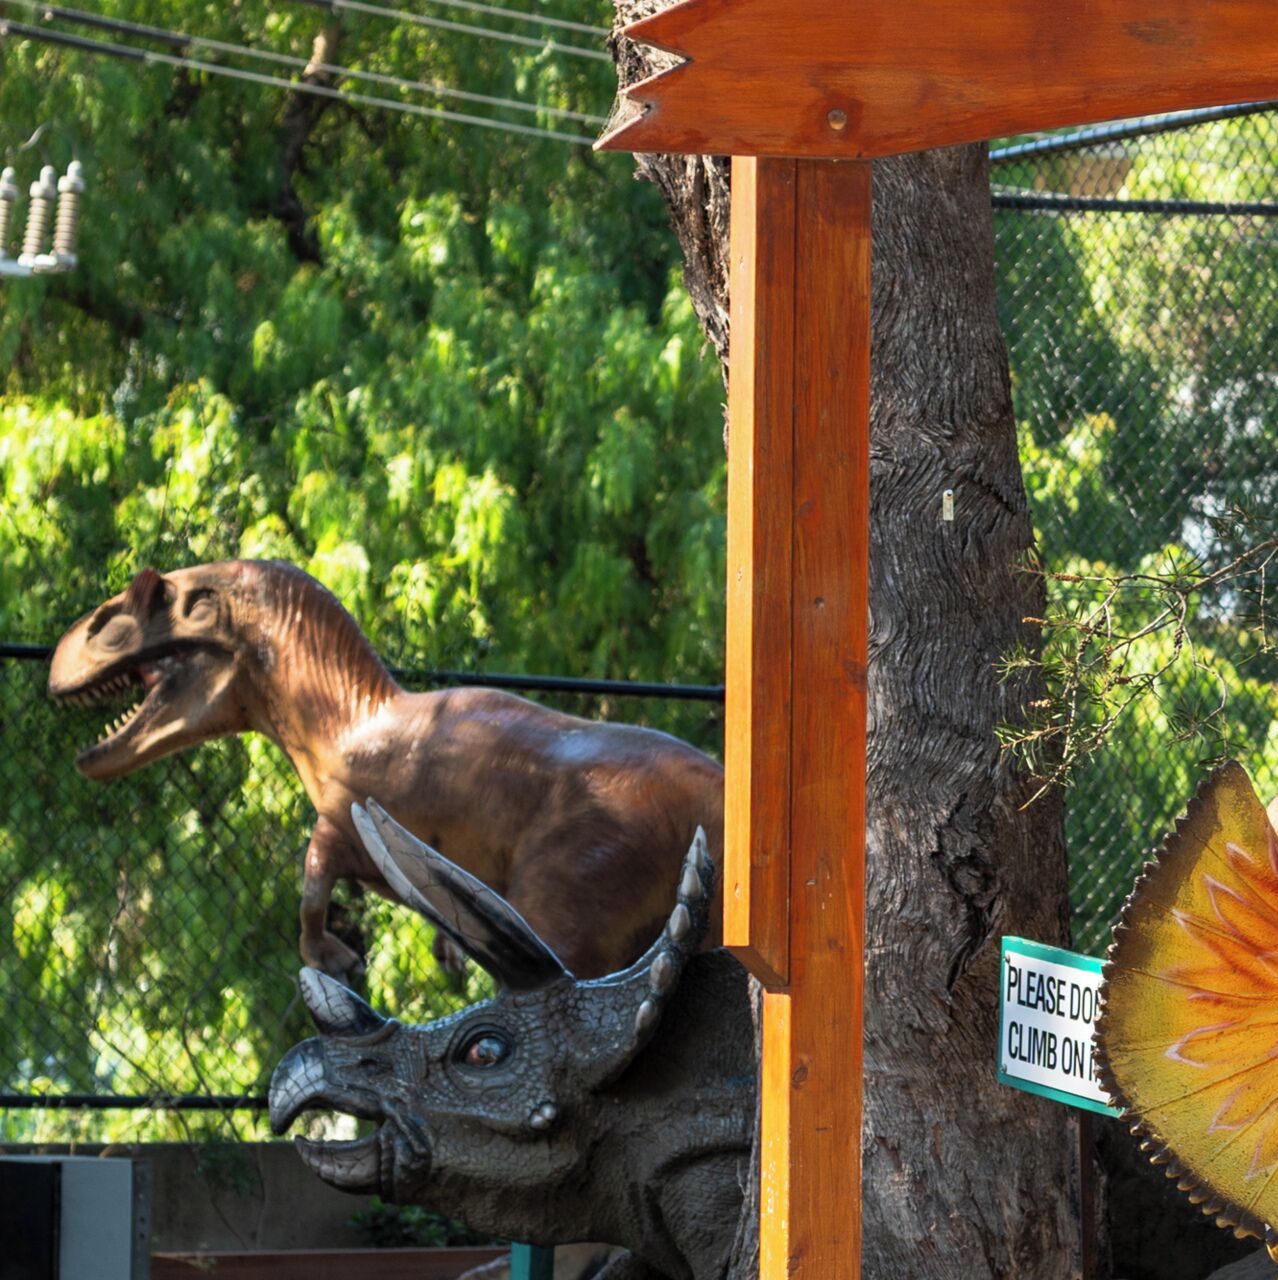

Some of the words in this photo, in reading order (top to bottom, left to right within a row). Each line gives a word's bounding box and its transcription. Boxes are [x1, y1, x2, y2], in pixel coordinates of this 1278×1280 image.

[1007, 965, 1066, 1017] PLEASE
[1008, 1021, 1057, 1070] CLIMB
[1062, 1037, 1085, 1078] ON
